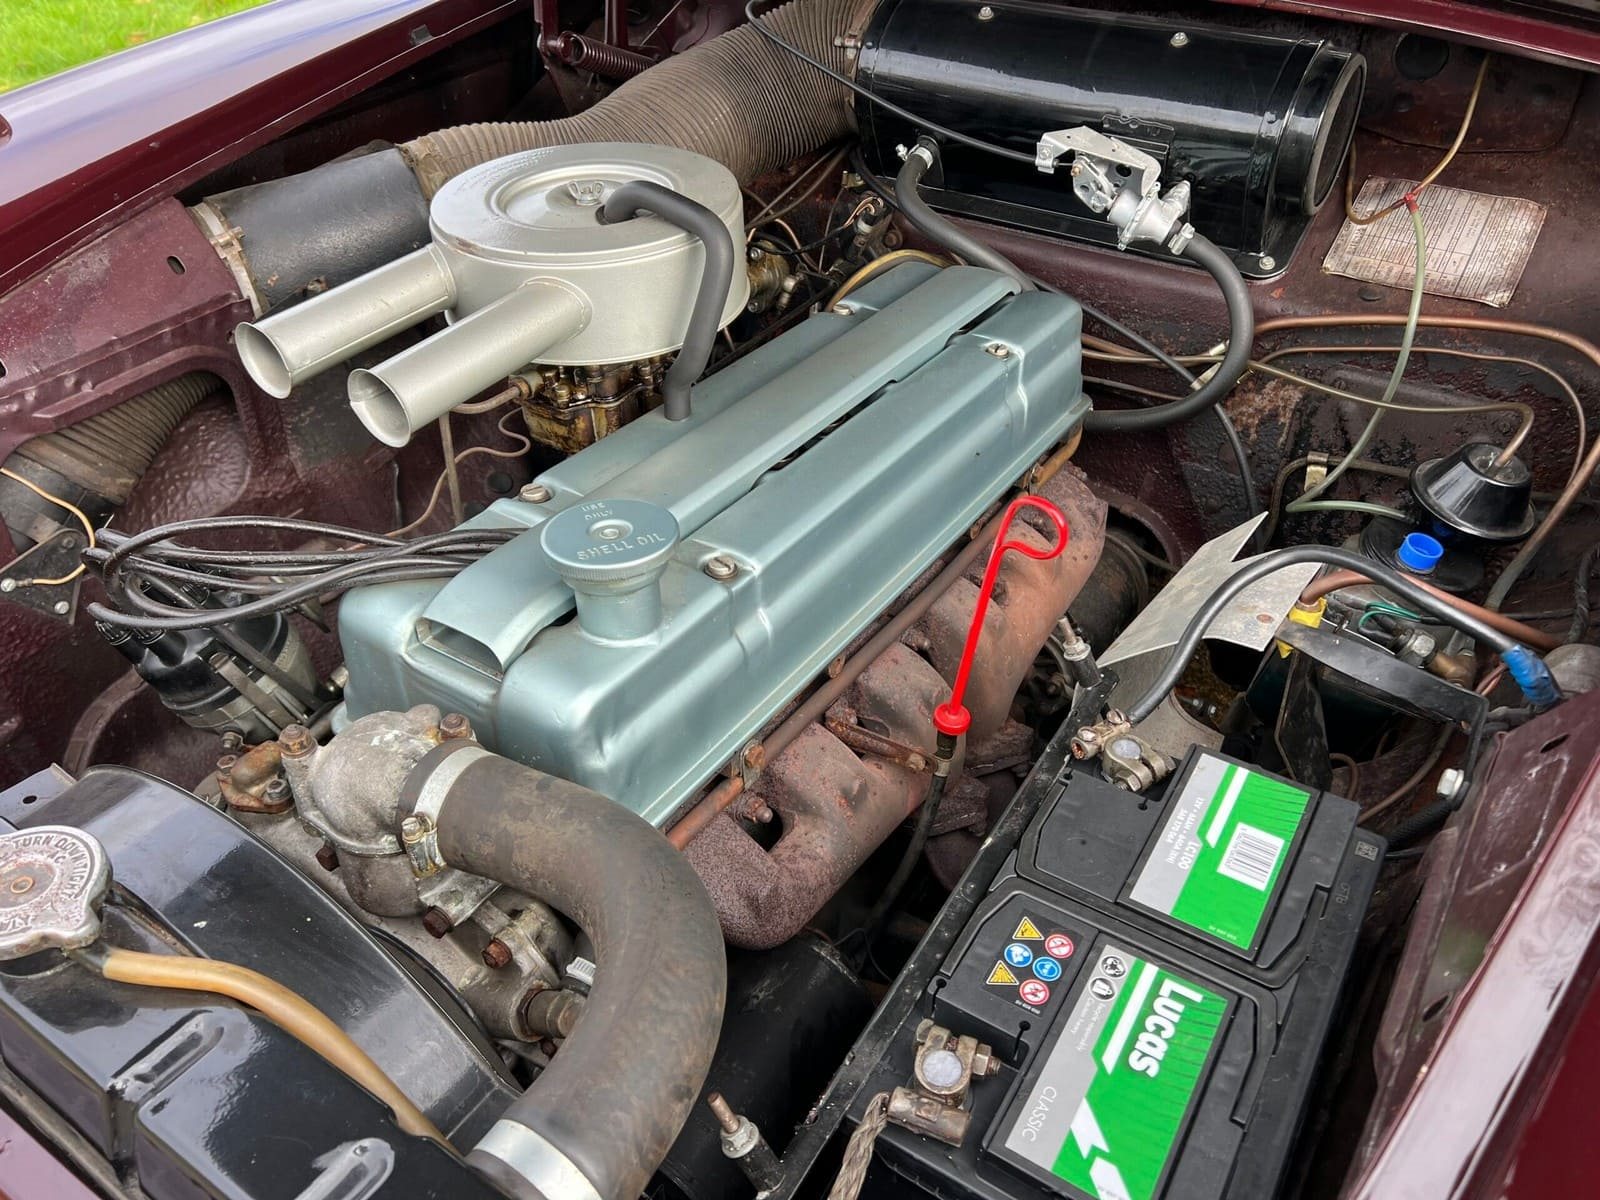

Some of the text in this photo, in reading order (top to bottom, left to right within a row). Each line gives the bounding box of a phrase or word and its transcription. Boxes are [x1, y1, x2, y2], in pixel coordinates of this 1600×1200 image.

[582, 502, 606, 512] USE
[577, 533, 666, 560] SHELL OIL
[13, 835, 87, 899] TURN DOWN TIGHT
[1177, 841, 1200, 870] LC100
[1128, 978, 1203, 1078] Lucas
[1022, 1086, 1057, 1141] CLASSIC
